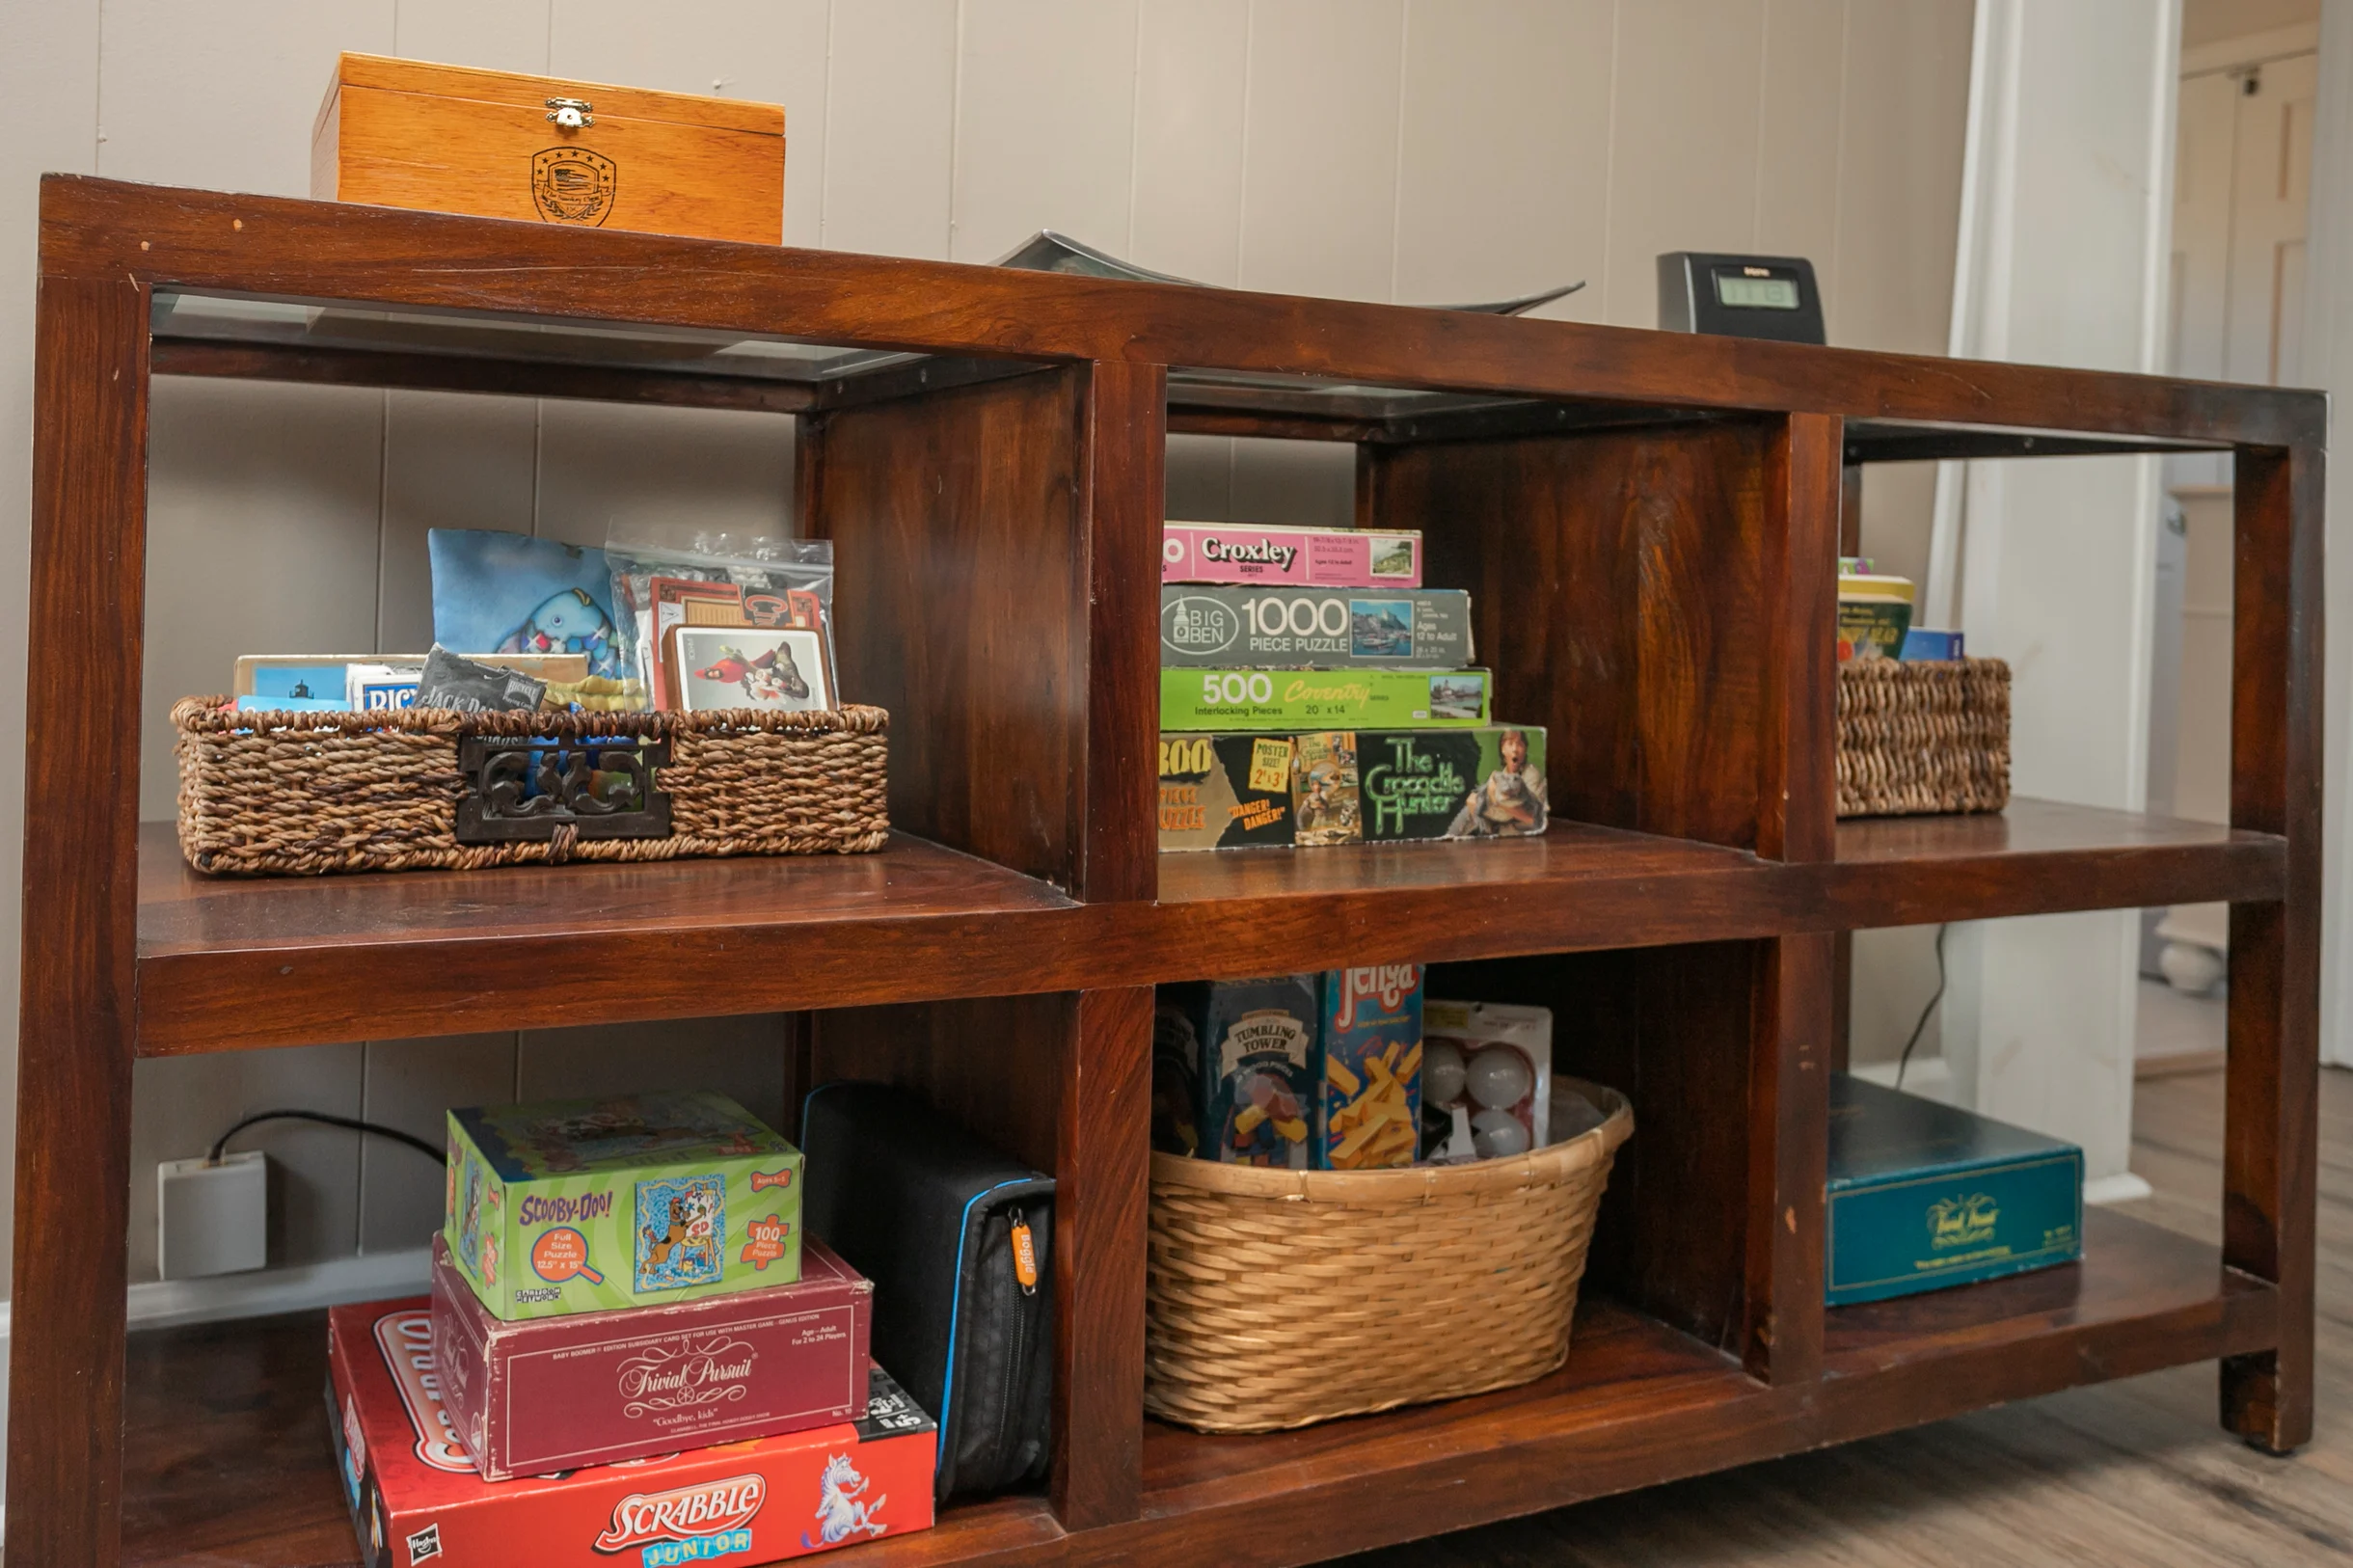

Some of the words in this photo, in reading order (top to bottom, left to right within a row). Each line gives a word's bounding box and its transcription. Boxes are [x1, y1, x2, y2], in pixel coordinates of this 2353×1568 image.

[1163, 538, 1185, 563] 0
[1202, 537, 1296, 572] Croxley
[1190, 610, 1224, 627] BIG
[1242, 597, 1348, 636] 1000
[1190, 627, 1224, 643] BEN
[1250, 637, 1290, 652] PIECE
[1295, 638, 1348, 652] PUZZLE
[420, 685, 465, 712] JACK
[1204, 673, 1273, 704] 500
[1284, 680, 1370, 709] Coventry
[1195, 706, 1250, 716] Interlocking
[1252, 706, 1283, 716] Pieces
[1257, 743, 1288, 758] POSTER
[1384, 737, 1433, 772] The
[1262, 757, 1281, 768] SIZE!
[1365, 762, 1465, 801] Crocodile
[1160, 805, 1206, 829] UZZLE
[1375, 796, 1458, 835] Hunter
[1234, 1025, 1296, 1043] TUMBLING
[1243, 1038, 1287, 1053] TOWER
[519, 1190, 613, 1227] SCOOBY-DOO!
[691, 1221, 709, 1237] SD
[755, 1227, 780, 1241] 100
[752, 1249, 777, 1257] Puzzle
[756, 1241, 777, 1250] Piece
[1019, 1234, 1035, 1273] Boggle
[516, 1287, 561, 1298] CARTOON
[516, 1294, 561, 1303] NETWORK
[571, 1349, 596, 1358] BOOMER
[604, 1342, 627, 1352] EDITION
[628, 1338, 663, 1348] SUBSIDIARY
[734, 1323, 757, 1333] MASTER
[758, 1320, 774, 1329] GAME
[798, 1314, 820, 1323] EDITION
[825, 1333, 847, 1341] Players
[619, 1364, 688, 1399] Trivial
[686, 1355, 752, 1387] Pursuit
[653, 1414, 696, 1426] "Goodbye,
[697, 1407, 718, 1419] kids"
[649, 1532, 749, 1566] JUNIOR
